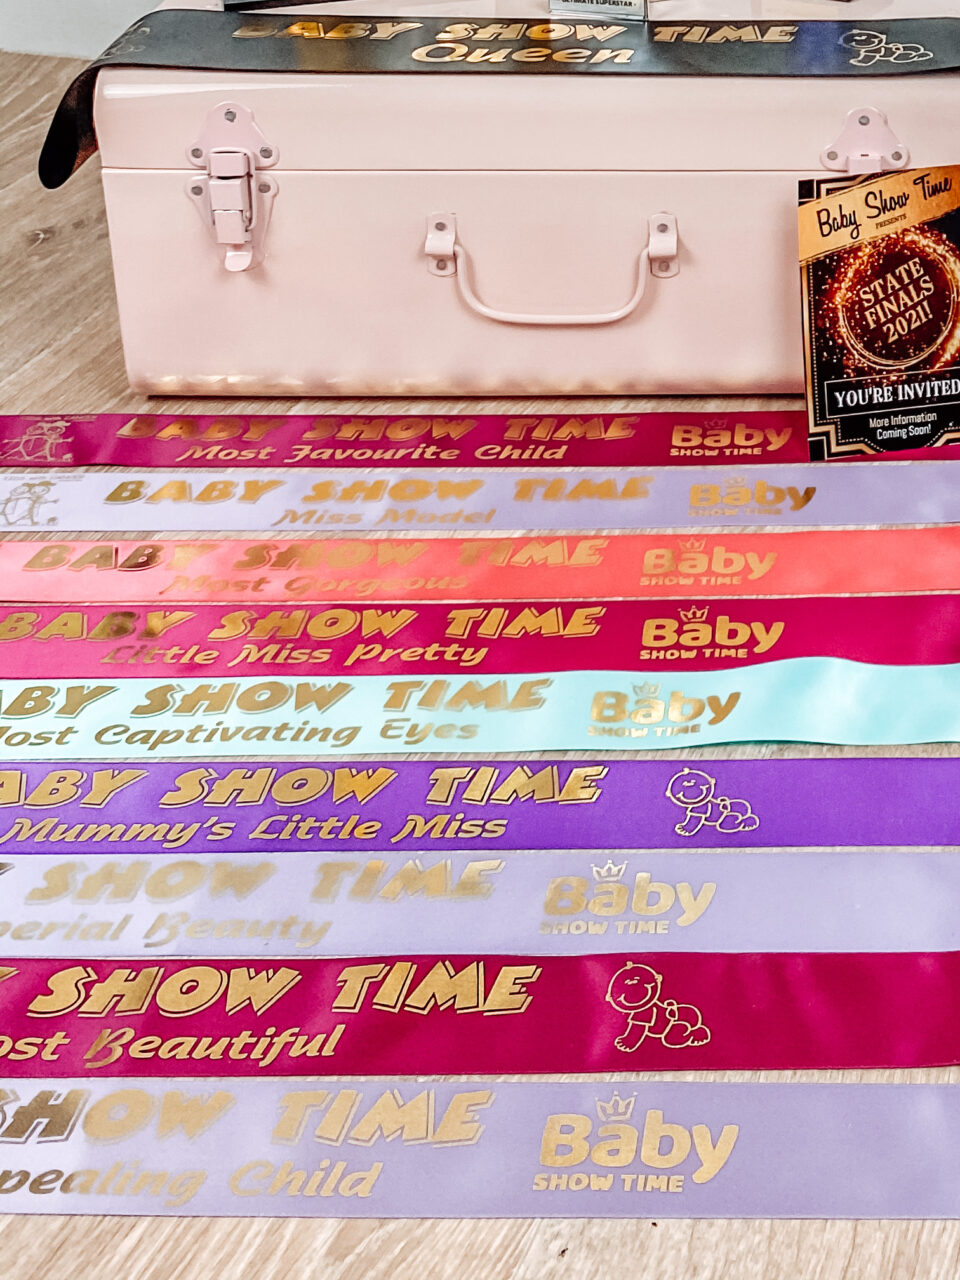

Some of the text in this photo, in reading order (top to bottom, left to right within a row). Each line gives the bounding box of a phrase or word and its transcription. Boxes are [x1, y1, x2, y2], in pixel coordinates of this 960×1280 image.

[596, 0, 632, 7] SUPERSTAR
[232, 22, 799, 43] BABY SHOW TIME
[411, 42, 635, 63] Queen
[817, 173, 952, 240] Baby Show Time
[875, 213, 907, 229] PRESENTS
[859, 257, 925, 308] STATE
[864, 275, 934, 330] FINALS
[882, 303, 934, 344] 2021!
[834, 384, 893, 408] YOU'RE
[116, 417, 640, 441] BABY SHOW TIME
[869, 412, 938, 428] More Information
[877, 423, 932, 439] Coming Soon!
[670, 447, 762, 456] SHOW TIME
[671, 423, 793, 451] Baby
[175, 444, 569, 462] Most Favourite Child
[103, 476, 655, 504] BABY SHOW TIME
[689, 480, 817, 511] Baby
[270, 508, 497, 527] Miss Model
[22, 539, 610, 571] BABY SHOW TIME
[642, 546, 778, 580] Baby
[159, 575, 469, 597] Most Gorgeous
[639, 576, 742, 586] SHOW TIME
[0, 607, 607, 642] BABY SHOW TIME
[641, 616, 785, 654] Baby
[101, 642, 488, 667] Little Miss Pretty
[639, 648, 749, 660] SHOW TIME
[0, 678, 552, 720] BY SHOW TIME
[590, 691, 742, 726] Baby
[94, 721, 362, 751] Captivating
[380, 718, 480, 745] Eyes
[587, 724, 701, 738] SHOW TIME
[160, 767, 399, 807] SHOW
[427, 765, 608, 805] TIME
[0, 814, 508, 848] Mummy's Little Miss
[24, 858, 505, 904] SHOW TIME
[543, 872, 717, 927] Baby
[144, 913, 334, 949] Beauty
[539, 920, 671, 935] SHOW TIME
[26, 961, 542, 1018] SHOW TIME
[83, 1023, 349, 1069] Beautiful
[270, 1089, 497, 1148] TIME
[539, 1109, 741, 1185] Baby
[229, 1160, 384, 1199] Child
[532, 1173, 684, 1192] SHOW TIME
